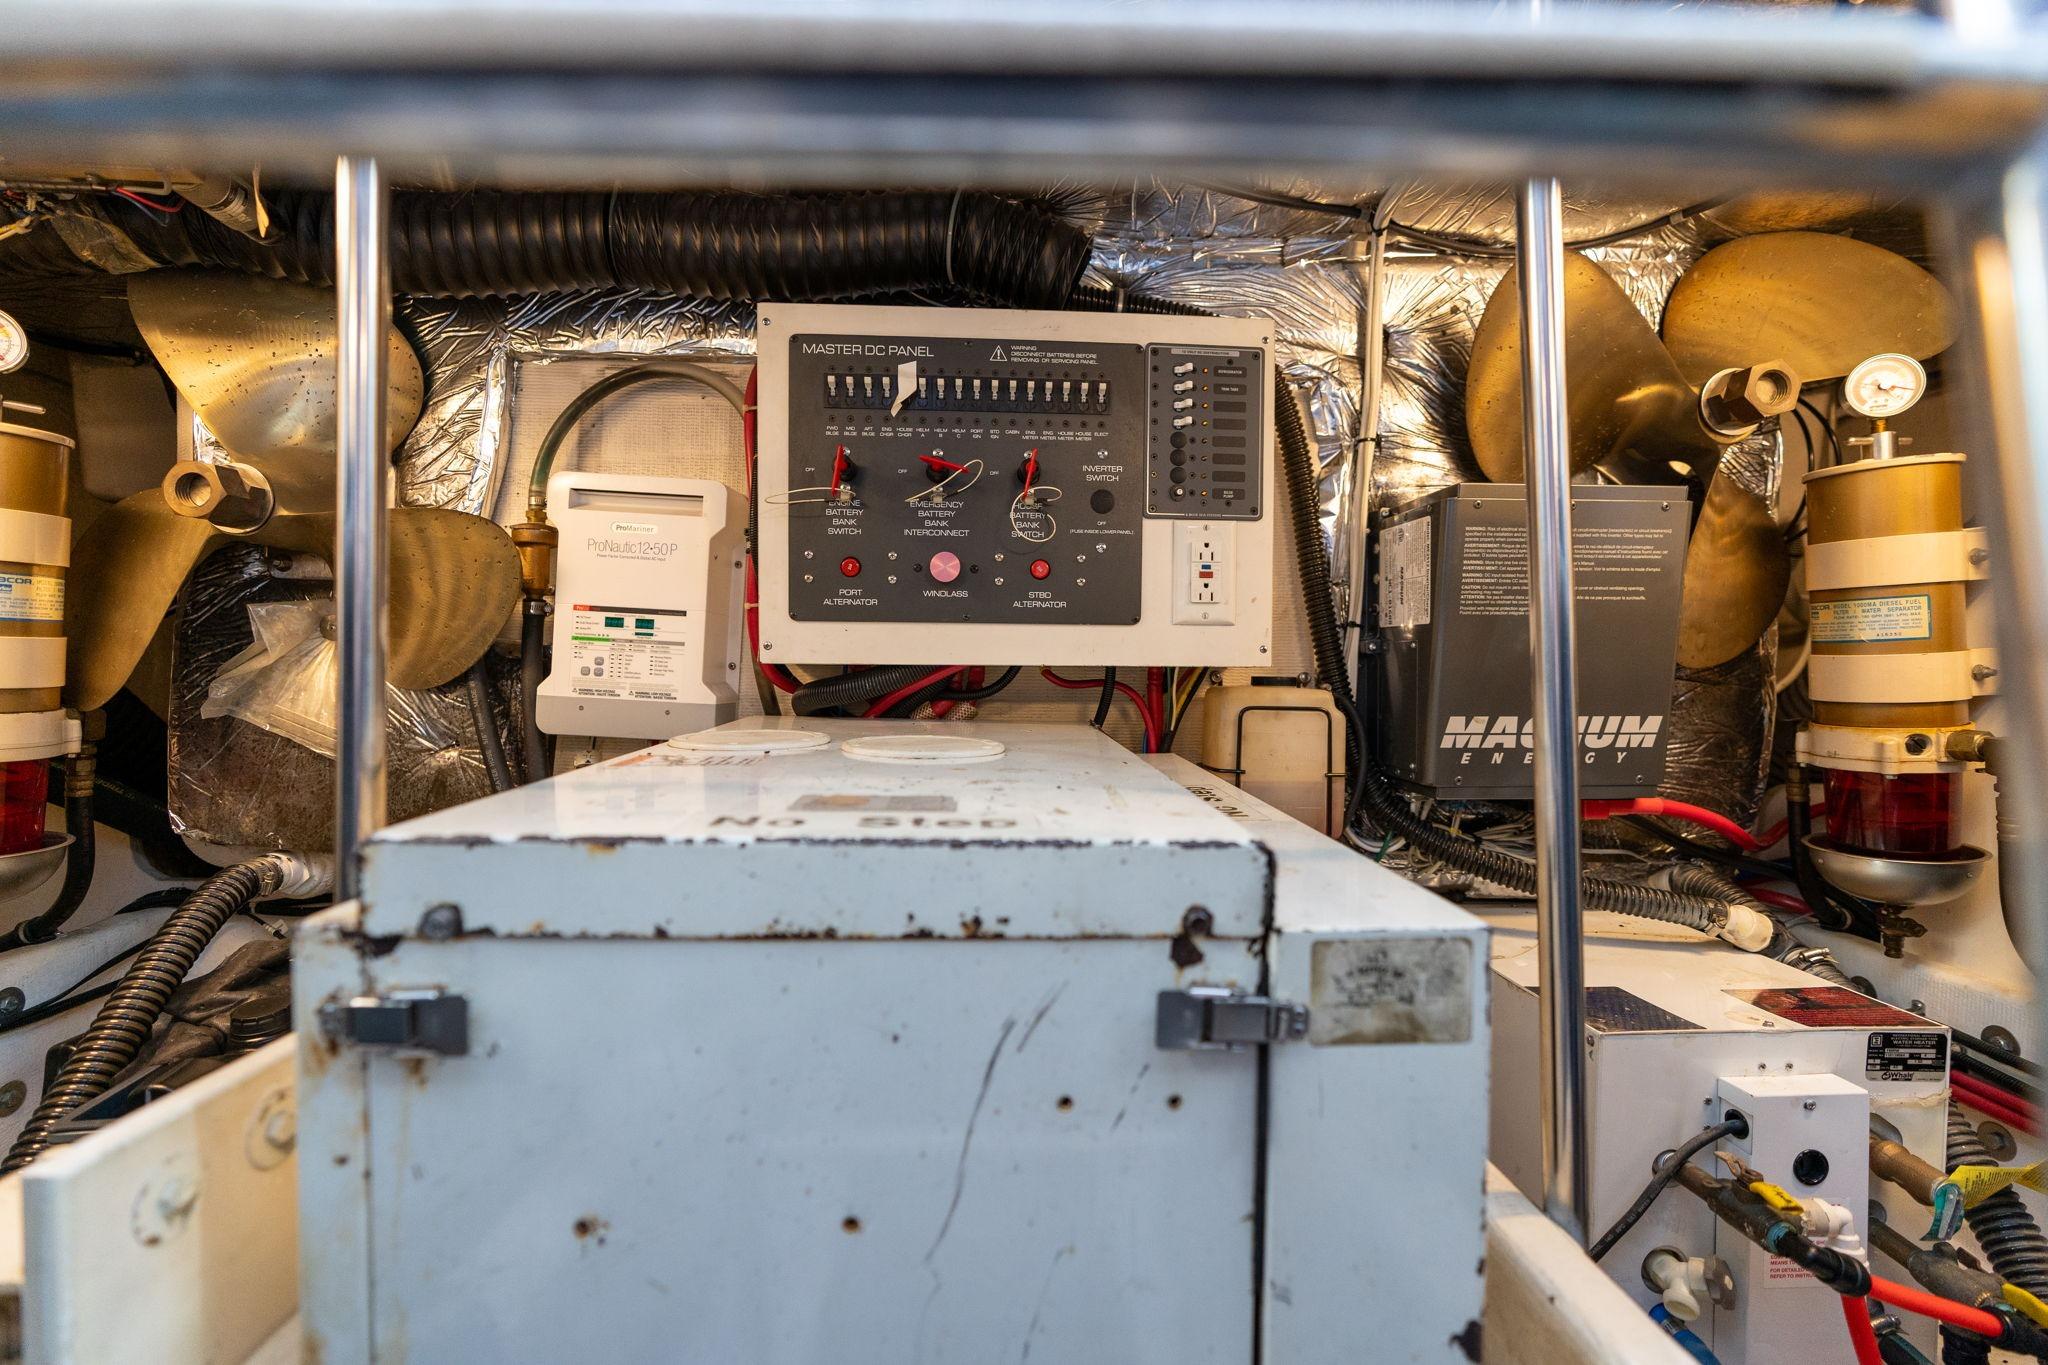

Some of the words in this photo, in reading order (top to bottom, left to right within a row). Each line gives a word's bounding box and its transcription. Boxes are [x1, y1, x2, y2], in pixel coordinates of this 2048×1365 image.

[802, 343, 862, 355] MASTER
[865, 345, 885, 356] DC
[889, 345, 934, 357] PANEL
[910, 500, 964, 508] EMERGENCY
[616, 524, 654, 533] ProMariner
[587, 538, 636, 553] ProNautic
[1440, 715, 1663, 749] MAUM
[1460, 752, 1628, 764] ENEGY
